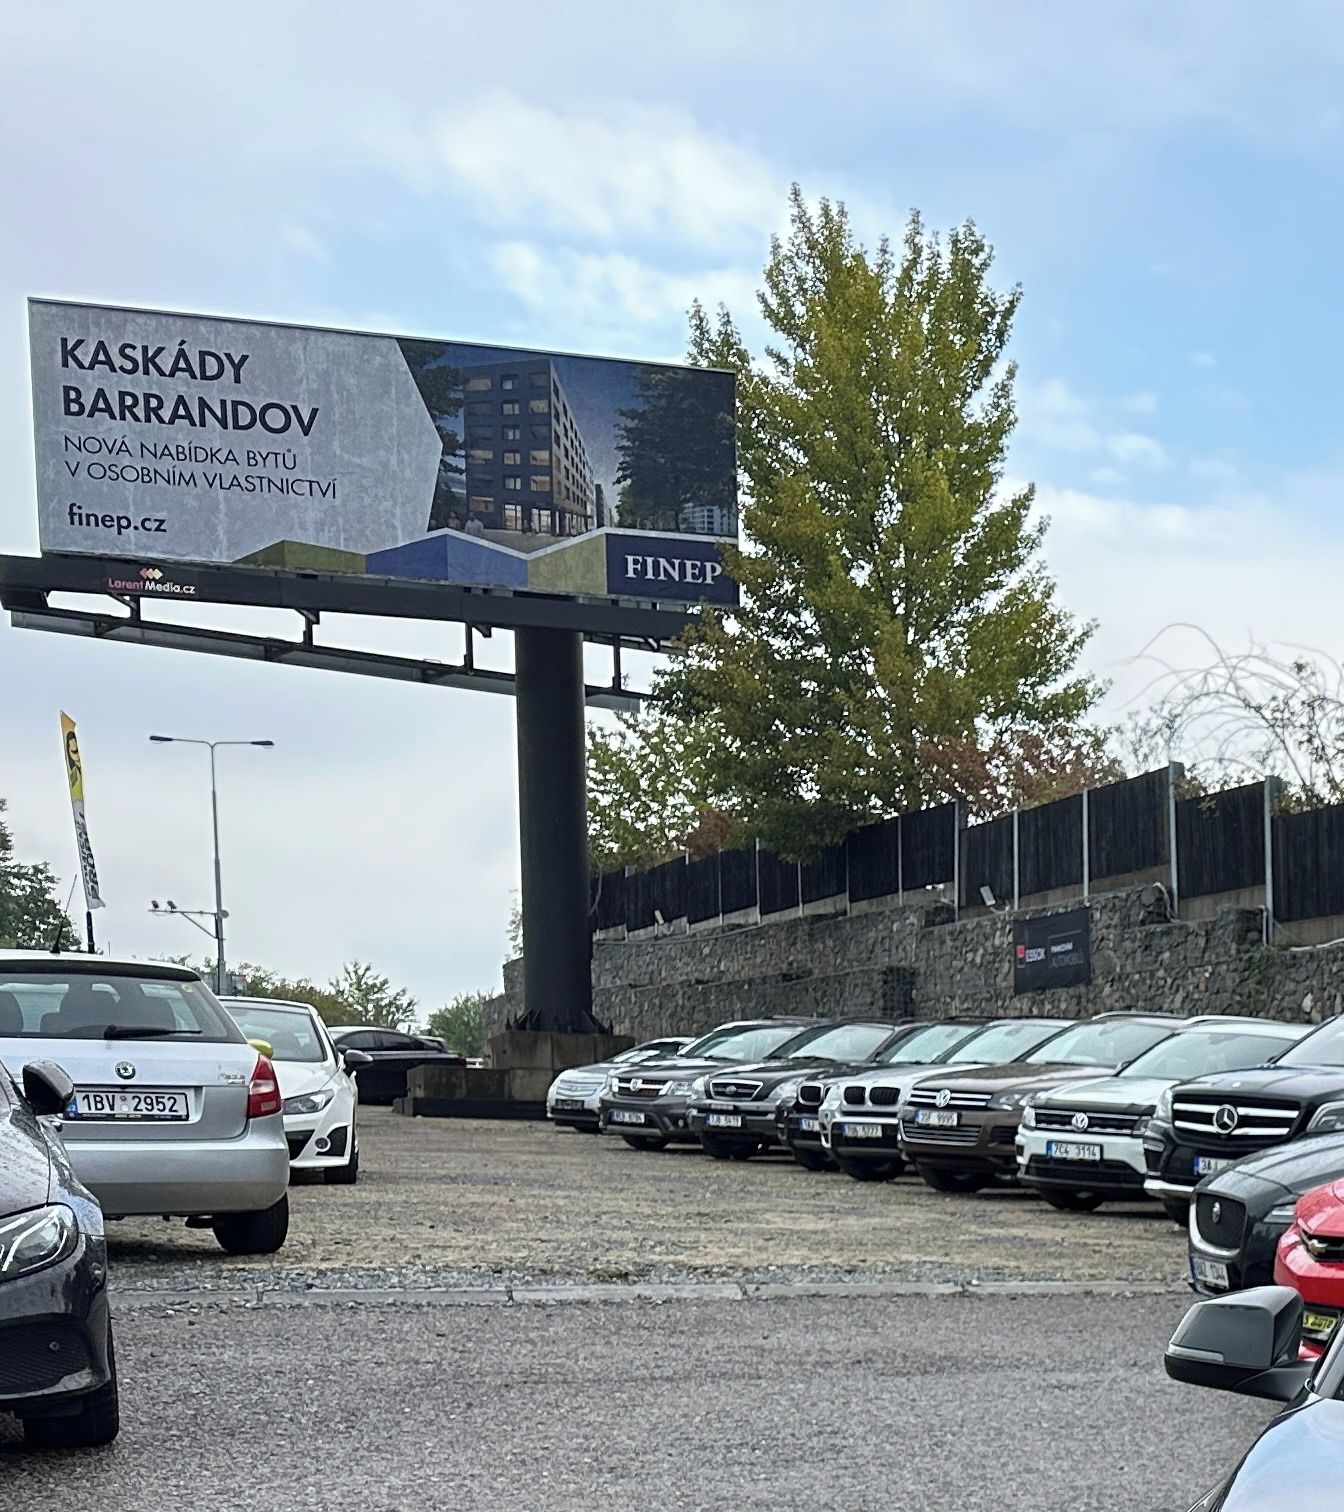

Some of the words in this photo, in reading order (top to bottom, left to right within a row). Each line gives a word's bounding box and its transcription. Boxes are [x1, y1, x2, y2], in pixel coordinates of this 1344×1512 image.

[60, 337, 249, 384] KASKÁDY
[62, 385, 319, 436] BARRANDOV
[64, 435, 133, 458] NOVÁ
[140, 441, 240, 466] NABÍDKA
[247, 448, 297, 470] BYTŮ
[65, 461, 80, 478] V
[87, 462, 197, 488] OSOBNÍM
[203, 472, 337, 499] VLASTNICTVÍ
[68, 502, 167, 535] finep.cz
[625, 554, 722, 584] FINEP
[82, 1094, 116, 1113] 1BV
[131, 1095, 179, 1113] 2952
